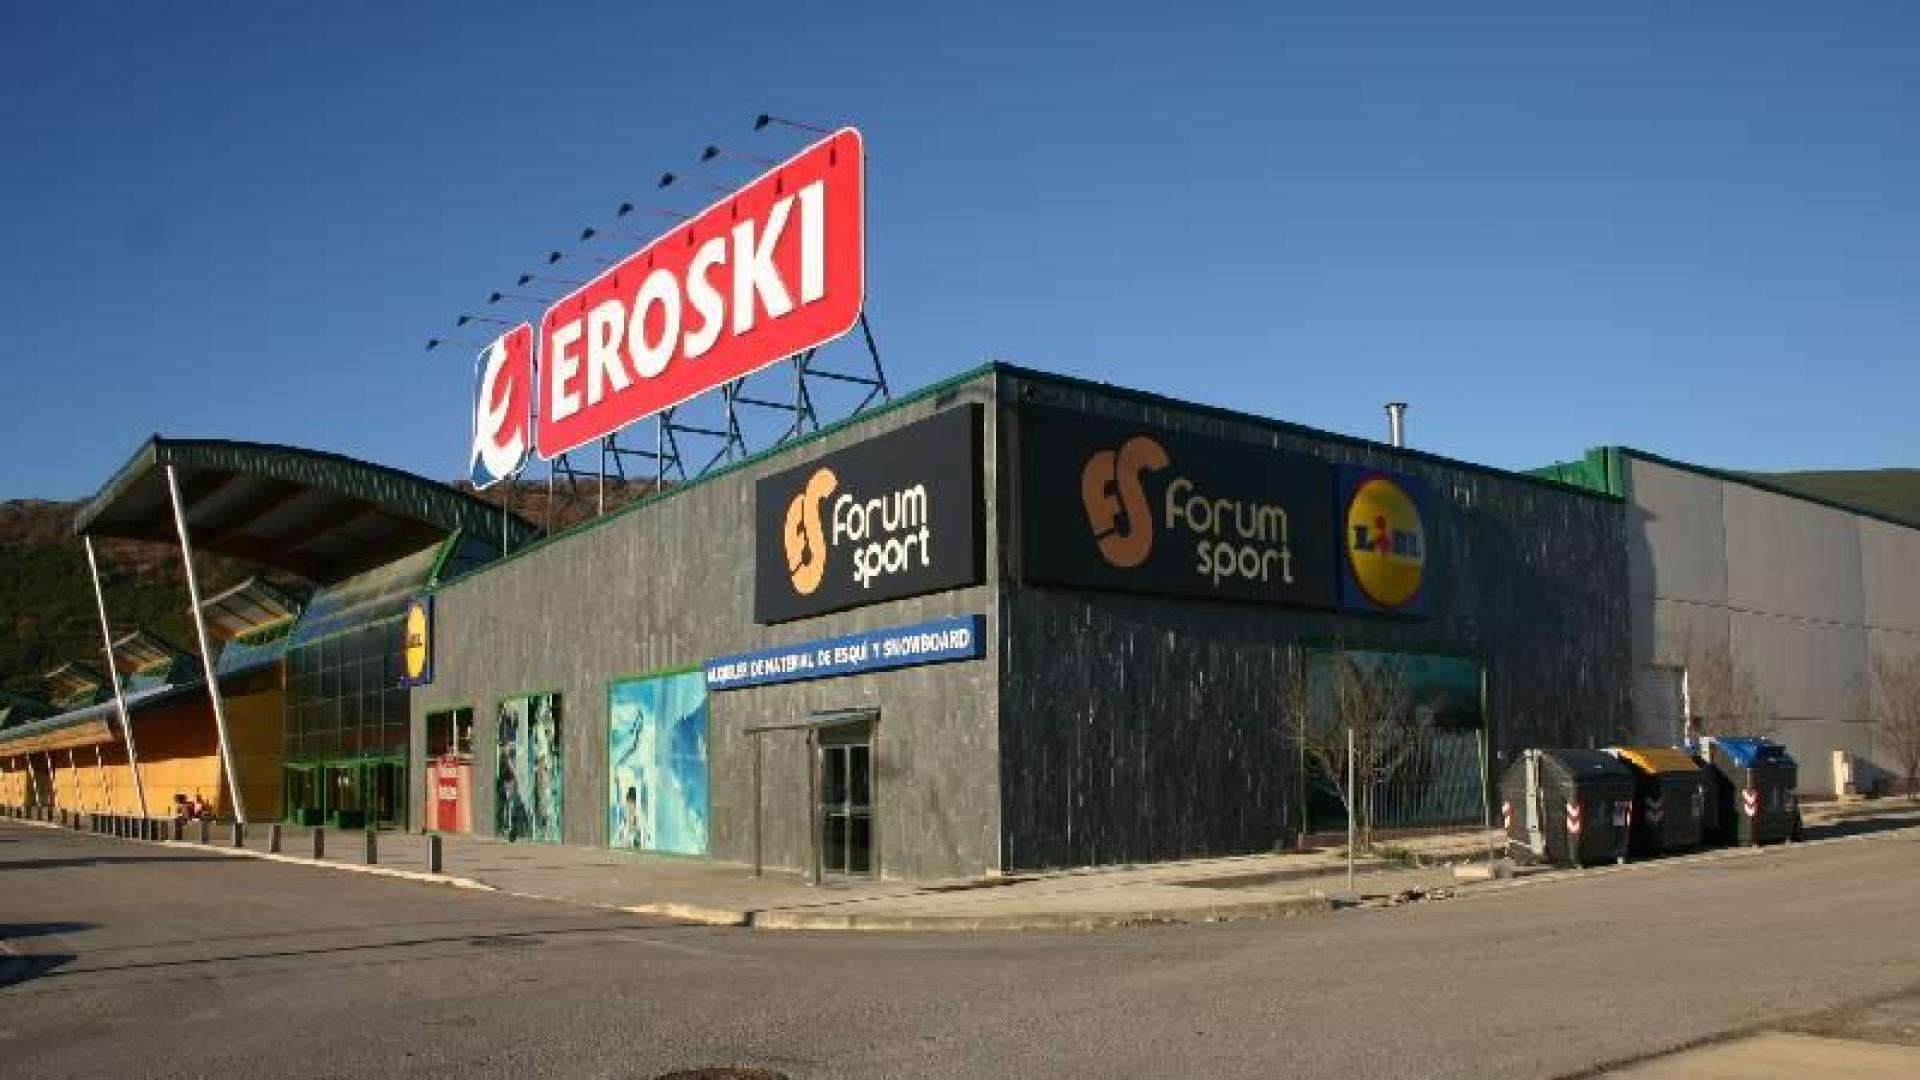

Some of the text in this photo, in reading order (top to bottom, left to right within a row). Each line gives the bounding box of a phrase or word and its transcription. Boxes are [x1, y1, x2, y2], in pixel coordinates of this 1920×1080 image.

[551, 180, 825, 423] EROSKI
[853, 526, 930, 589] sport
[1197, 542, 1294, 587] sport
[817, 648, 832, 666] DE
[882, 627, 970, 656] SNOWBOARD
